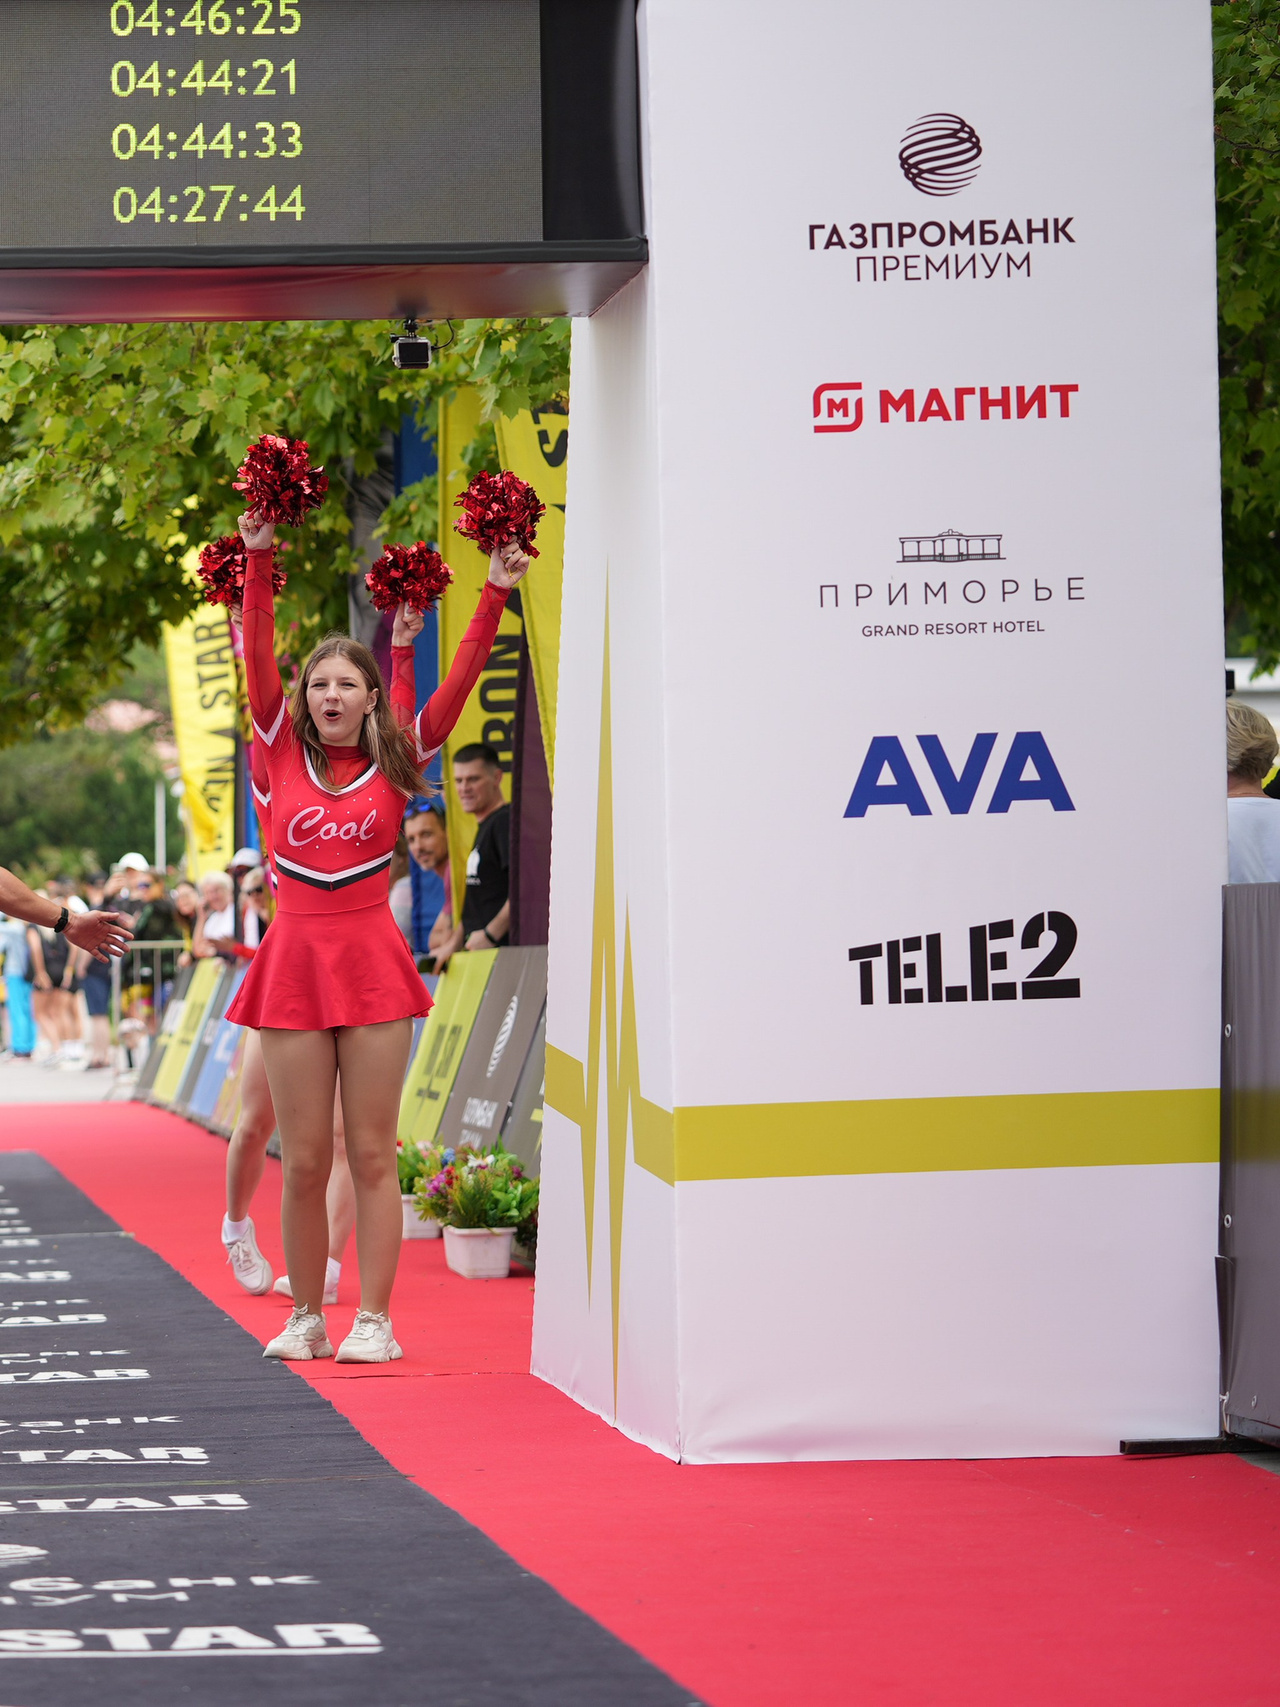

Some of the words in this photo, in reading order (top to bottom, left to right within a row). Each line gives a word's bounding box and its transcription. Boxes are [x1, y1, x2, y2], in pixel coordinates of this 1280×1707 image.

[110, 0, 302, 36] 04:46:25
[110, 58, 297, 97] 04:44:21
[110, 121, 303, 160] 04:44:33
[112, 184, 306, 223] 04:27:44
[807, 216, 1077, 251] ГАЗПРОМБАНК
[855, 251, 1032, 282] ПРЕМИУМ
[878, 383, 1080, 424] МАГНИТ
[819, 577, 1085, 608] ПРИМОРЬЕ
[861, 624, 920, 638] GRAND
[924, 621, 988, 636] RESORT
[993, 620, 1045, 633] HOTEL
[842, 730, 1077, 819] AVA
[287, 805, 377, 847] Cool
[847, 909, 1081, 1006] TELE2
